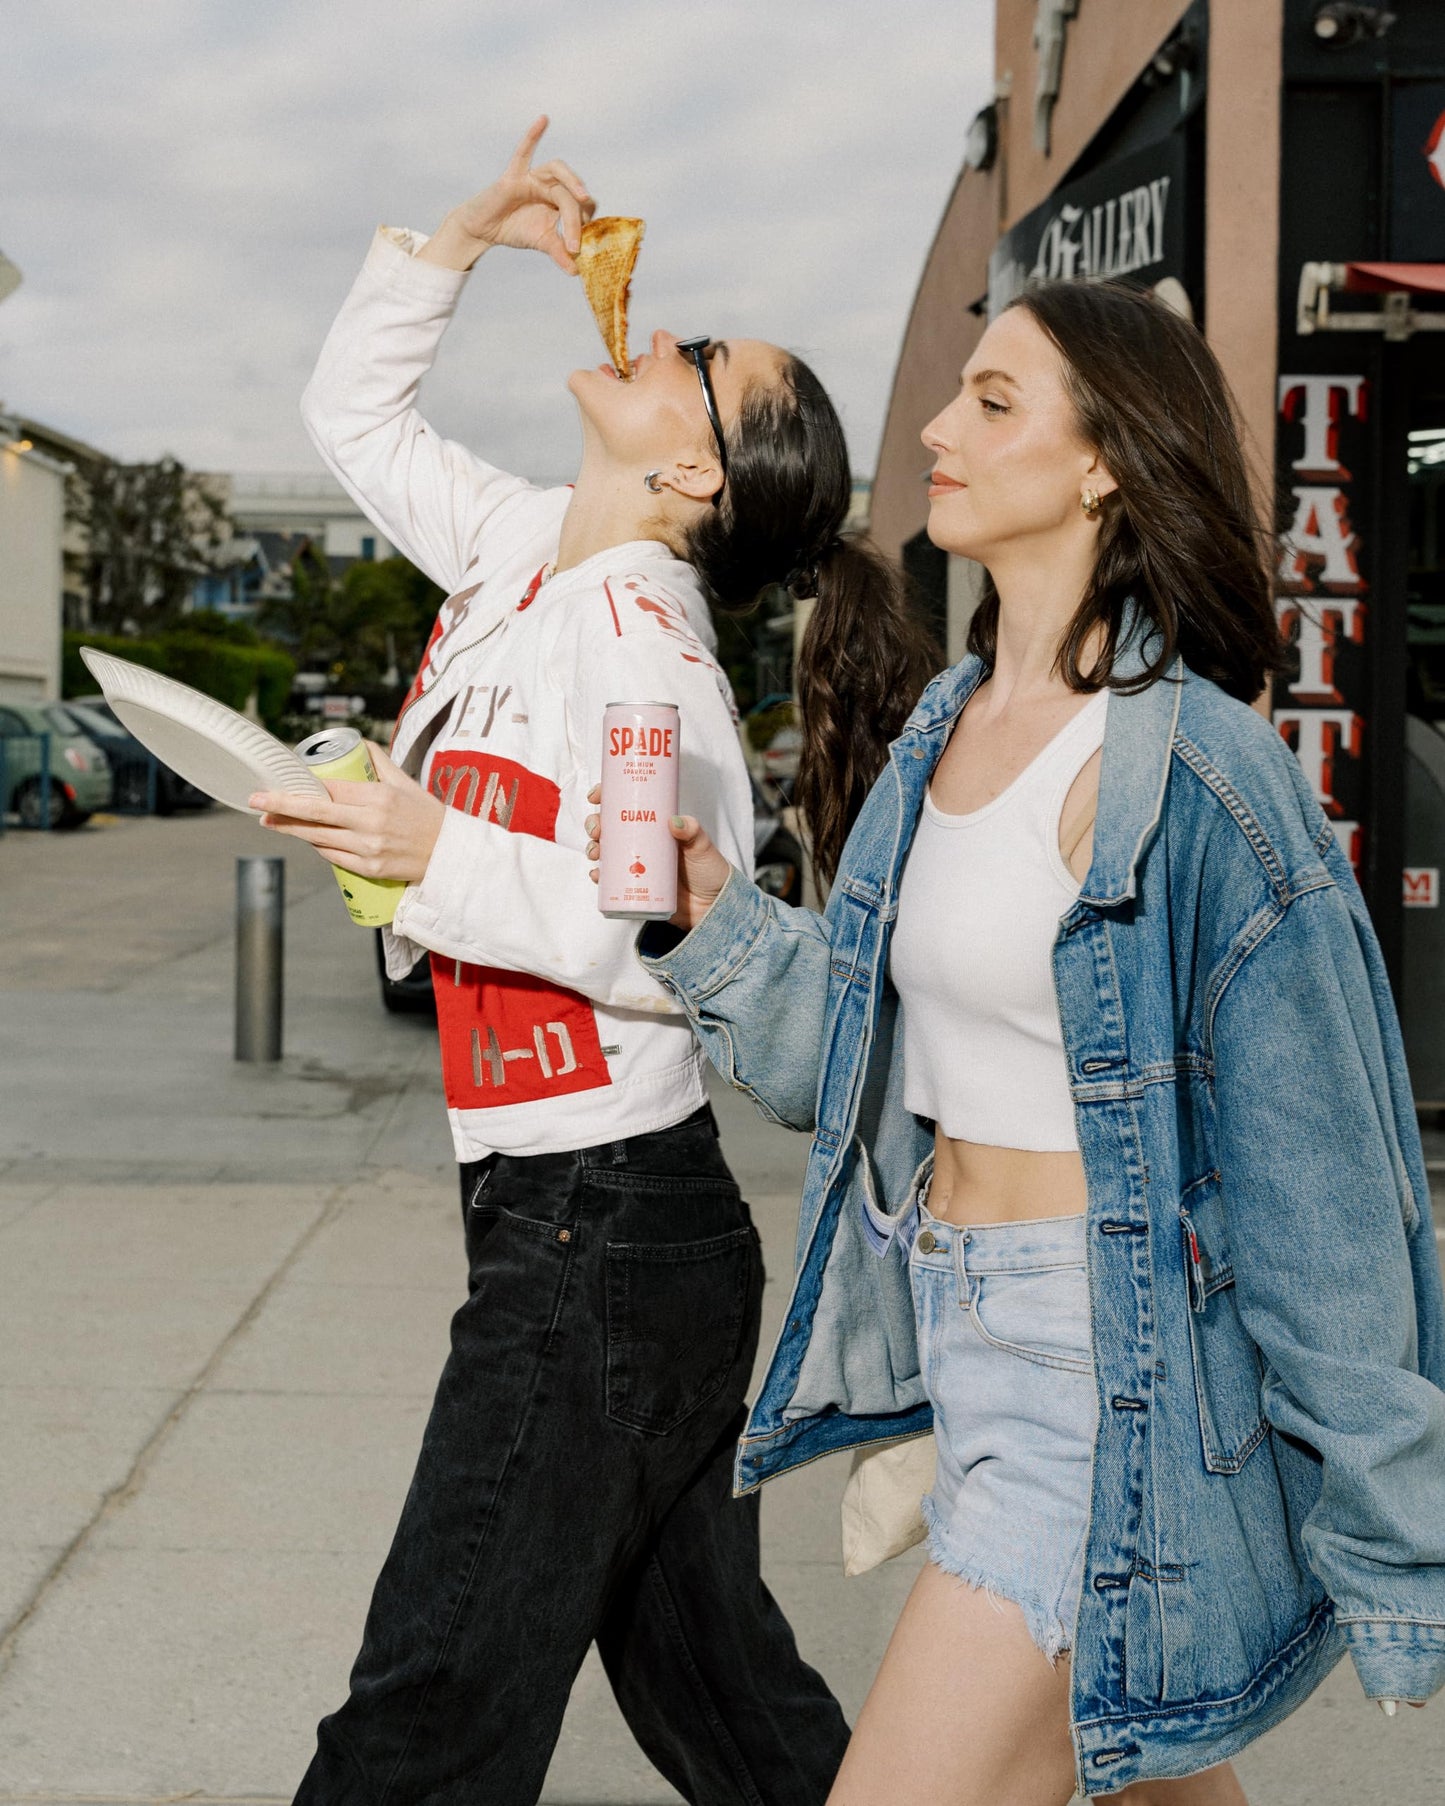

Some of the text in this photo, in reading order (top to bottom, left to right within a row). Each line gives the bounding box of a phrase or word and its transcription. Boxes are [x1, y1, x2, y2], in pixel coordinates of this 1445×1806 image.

[1031, 175, 1172, 285] GALLERY
[609, 727, 673, 758] SPADE
[620, 809, 657, 823] GUAVA
